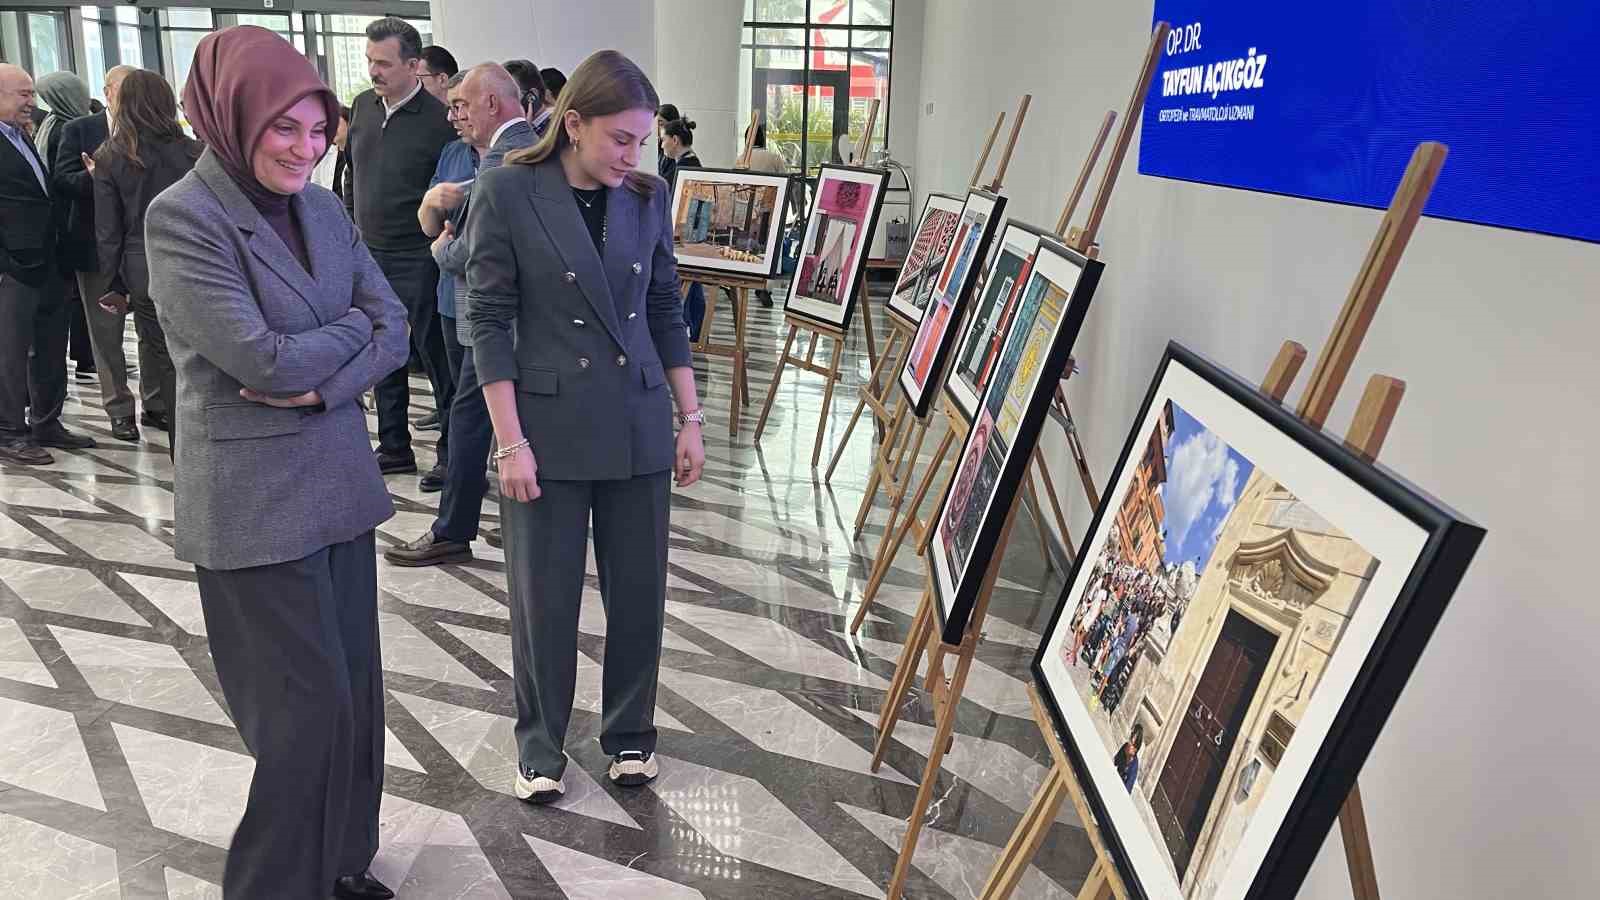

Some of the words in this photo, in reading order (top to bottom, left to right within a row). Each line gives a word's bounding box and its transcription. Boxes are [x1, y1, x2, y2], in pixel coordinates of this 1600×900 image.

[1166, 27, 1182, 56] OP.
[1163, 65, 1204, 97] TAYFUN
[1203, 47, 1267, 100] AÇIKGÖZ
